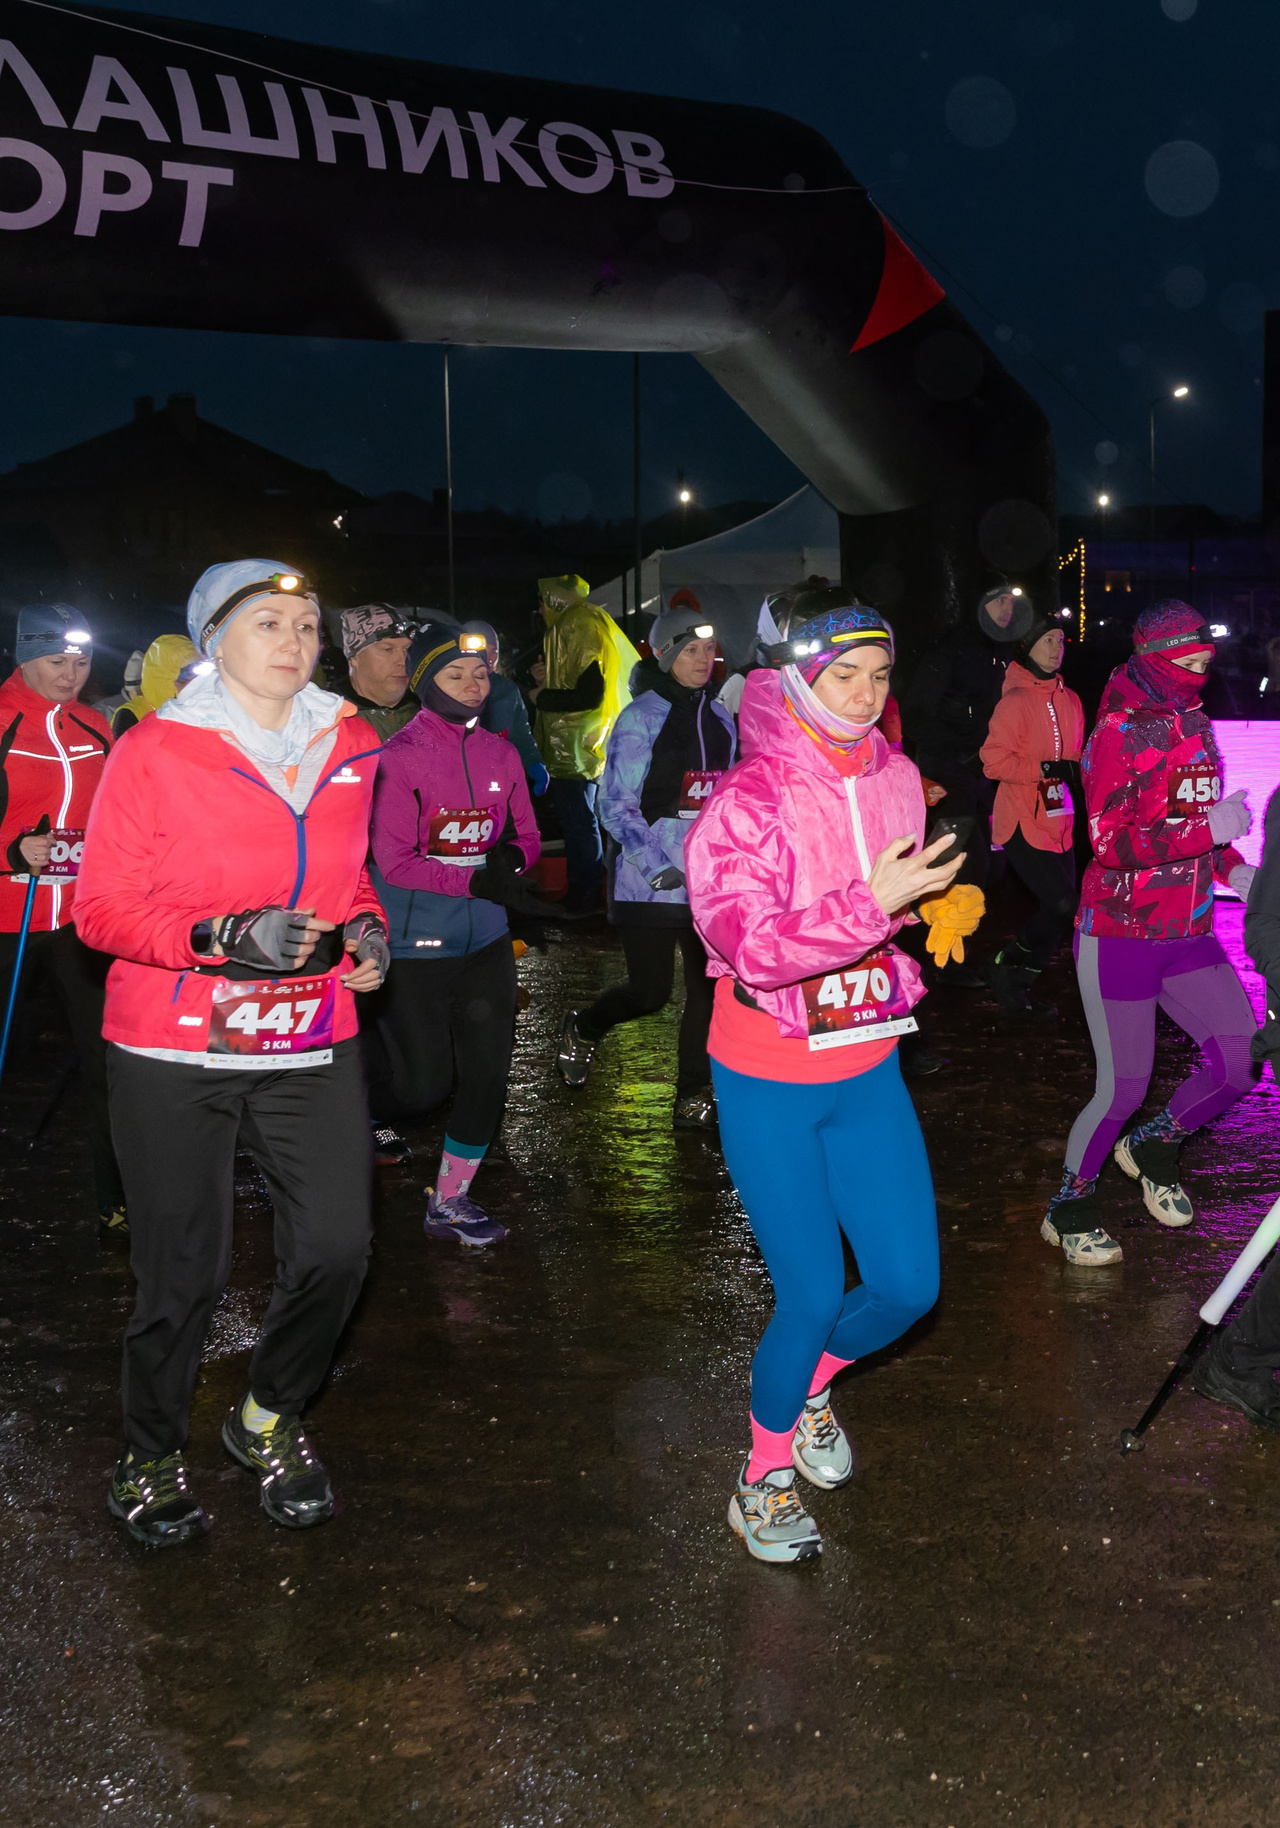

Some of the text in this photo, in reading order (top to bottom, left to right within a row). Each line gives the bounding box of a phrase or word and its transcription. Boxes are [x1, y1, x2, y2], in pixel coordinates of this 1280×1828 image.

[0, 137, 234, 248] ОРТ
[1166, 639, 1179, 647] LED
[687, 780, 720, 800] 44
[1047, 784, 1065, 800] 48
[1176, 776, 1221, 802] 458
[1198, 805, 1203, 813] 3
[439, 819, 494, 843] 449
[50, 840, 84, 863] 06
[817, 967, 891, 1009] 470
[226, 998, 322, 1035] 447
[853, 1009, 878, 1021] 3 KM
[262, 1040, 291, 1049] 3 KM
